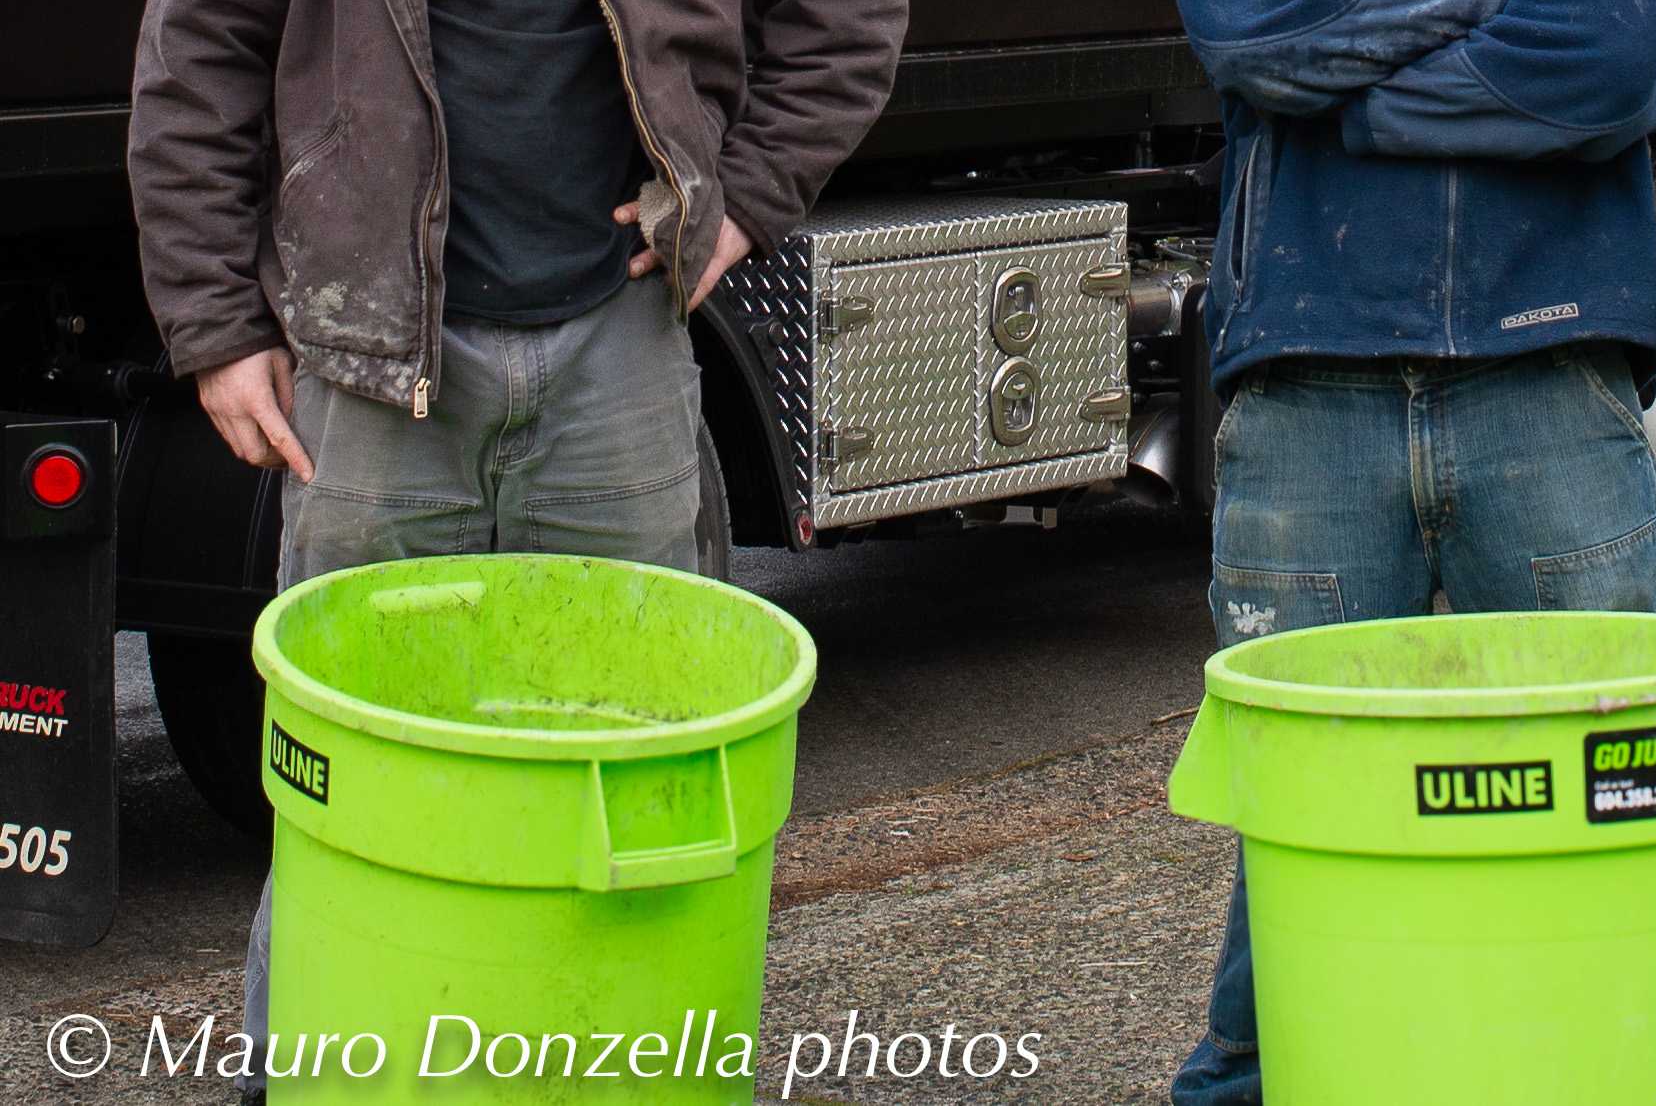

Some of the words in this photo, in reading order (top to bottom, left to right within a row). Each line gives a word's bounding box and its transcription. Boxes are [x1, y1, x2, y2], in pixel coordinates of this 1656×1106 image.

[1503, 305, 1575, 327] DAKOTA
[271, 731, 326, 797] ULINE
[1593, 741, 1631, 772] GO
[1422, 768, 1548, 810] ULINE
